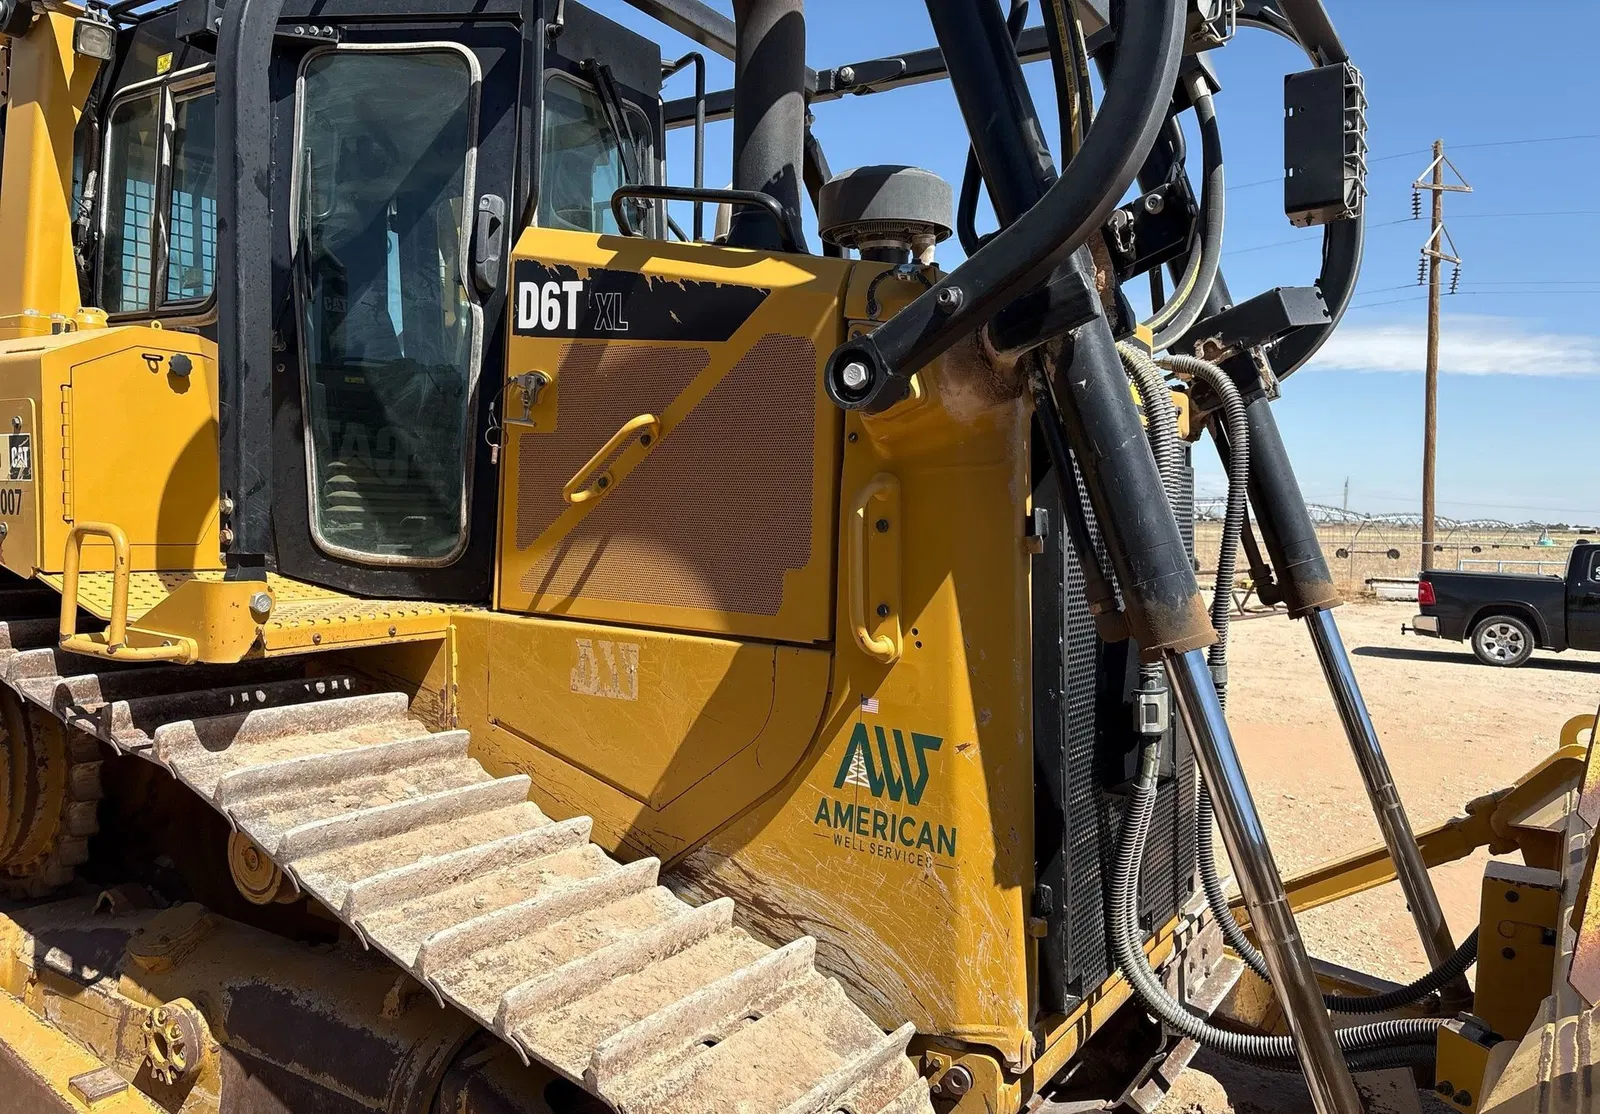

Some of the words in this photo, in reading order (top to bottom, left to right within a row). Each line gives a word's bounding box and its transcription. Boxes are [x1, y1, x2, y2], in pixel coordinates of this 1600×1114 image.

[518, 281, 583, 330] D6T
[594, 293, 628, 330] XL
[11, 446, 29, 469] CAT
[1, 488, 21, 515] 007
[814, 797, 957, 857] AMERICAN
[833, 833, 865, 852] WELL
[869, 842, 932, 868] SERVICES
